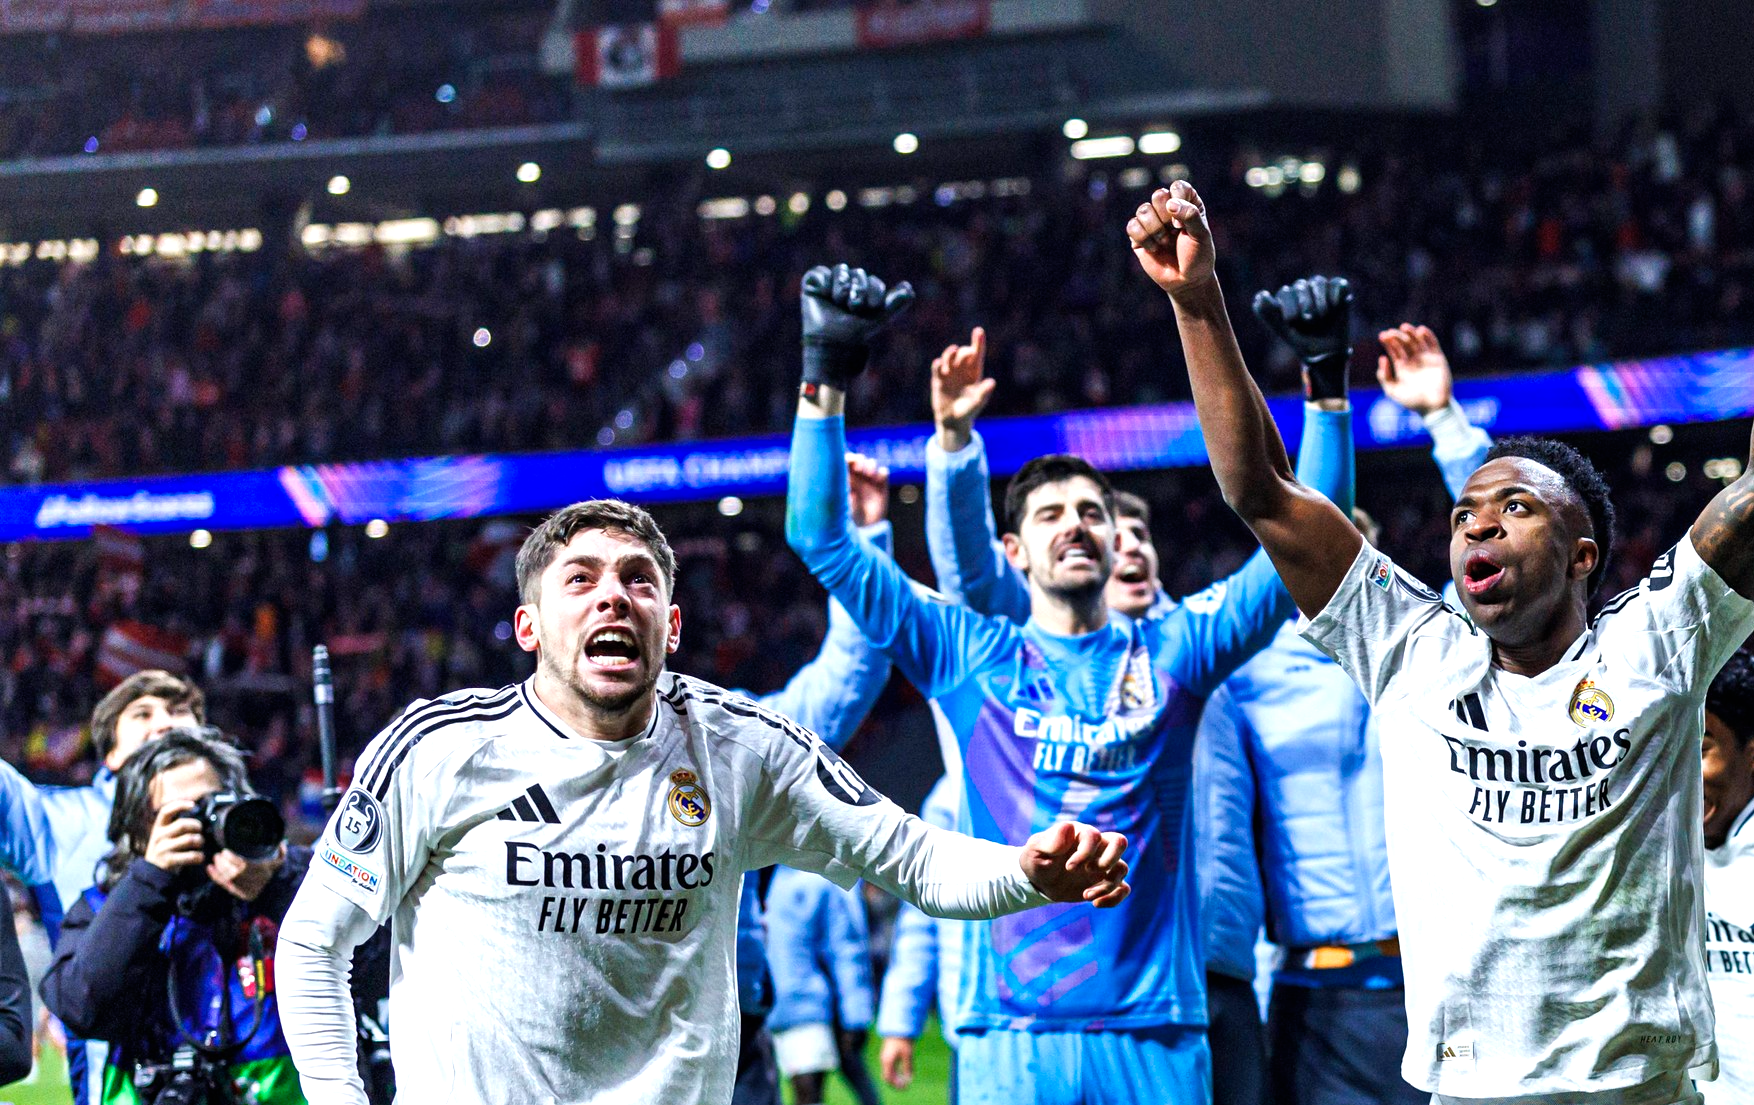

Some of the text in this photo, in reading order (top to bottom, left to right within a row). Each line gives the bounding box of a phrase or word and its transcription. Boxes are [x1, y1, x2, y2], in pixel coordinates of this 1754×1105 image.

[1033, 741, 1068, 771] FLY
[1441, 728, 1631, 785] Emirates
[1469, 777, 1612, 824] FLY BETTER
[345, 817, 361, 834] 15
[506, 841, 714, 892] Emirates
[538, 896, 688, 935] FLY BETTER
